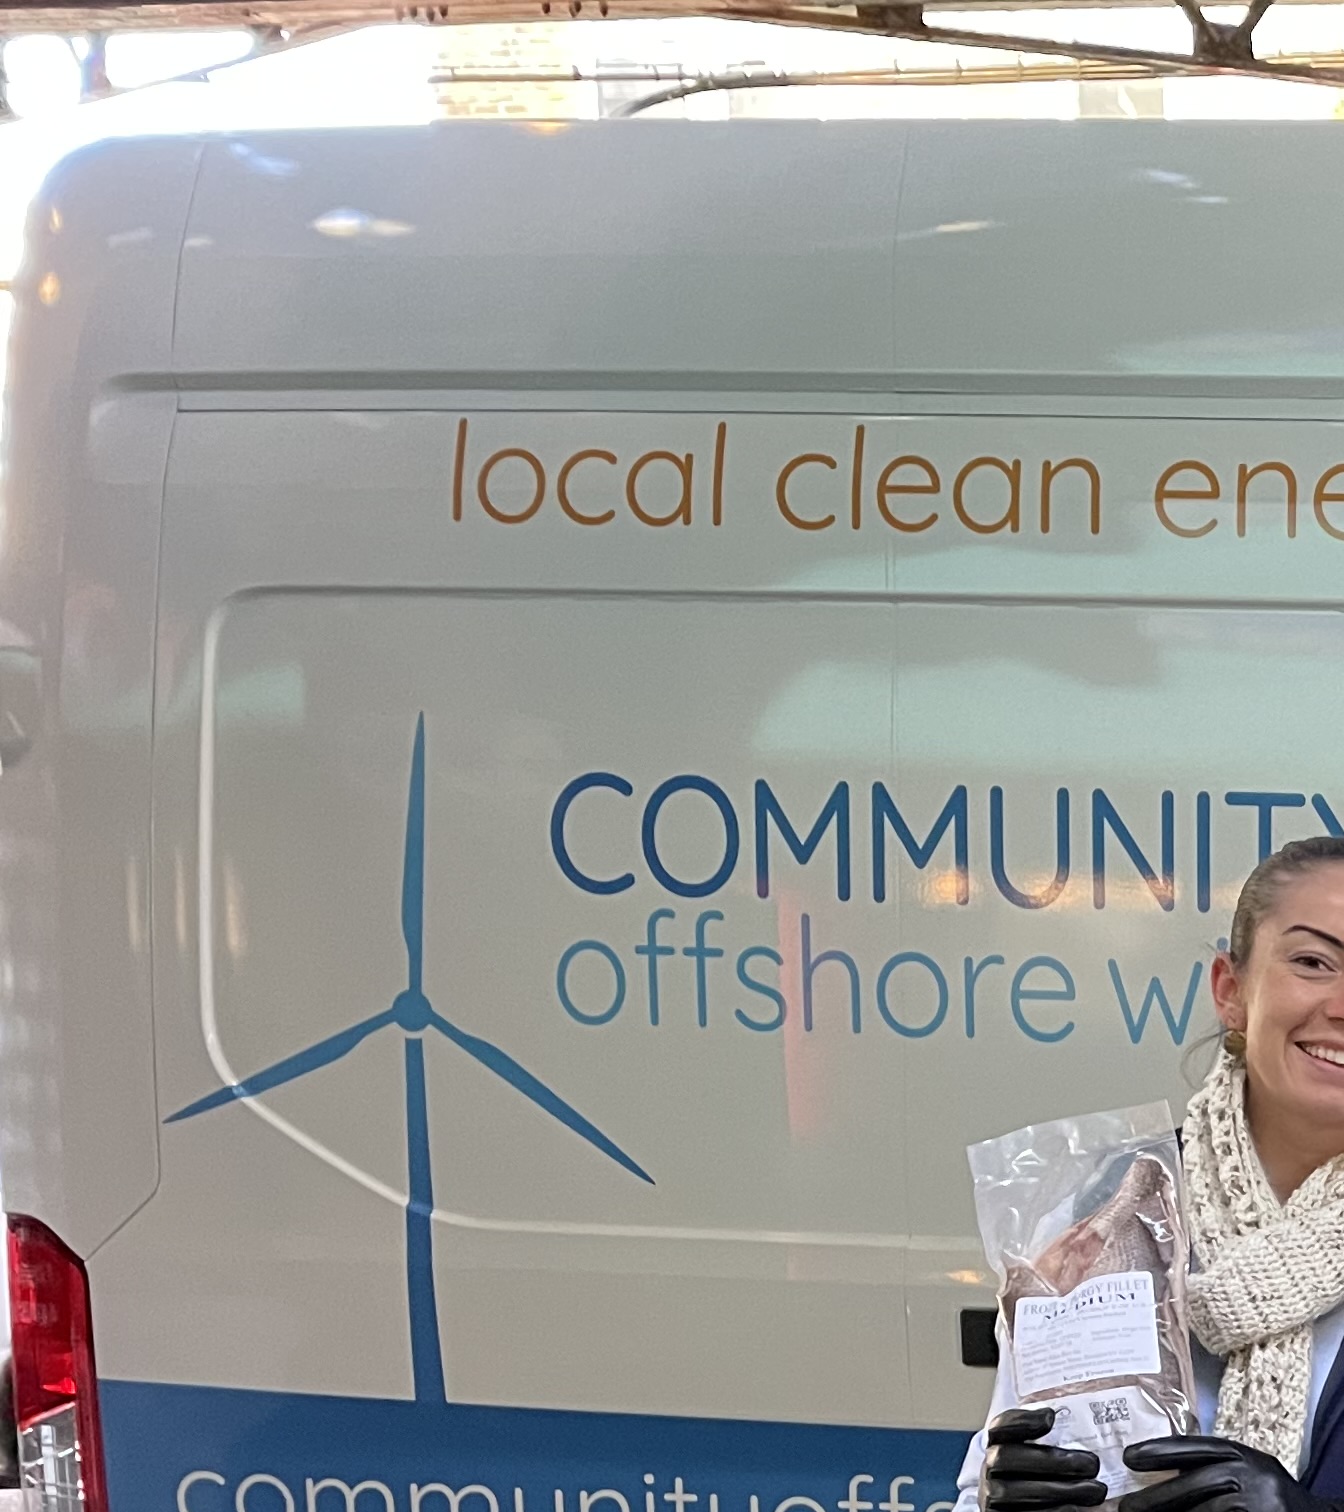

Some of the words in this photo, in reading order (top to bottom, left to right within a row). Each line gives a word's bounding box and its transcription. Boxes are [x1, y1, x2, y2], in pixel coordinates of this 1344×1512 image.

[452, 416, 728, 529] local
[774, 423, 1101, 535] clean
[556, 907, 1076, 1044] offshore
